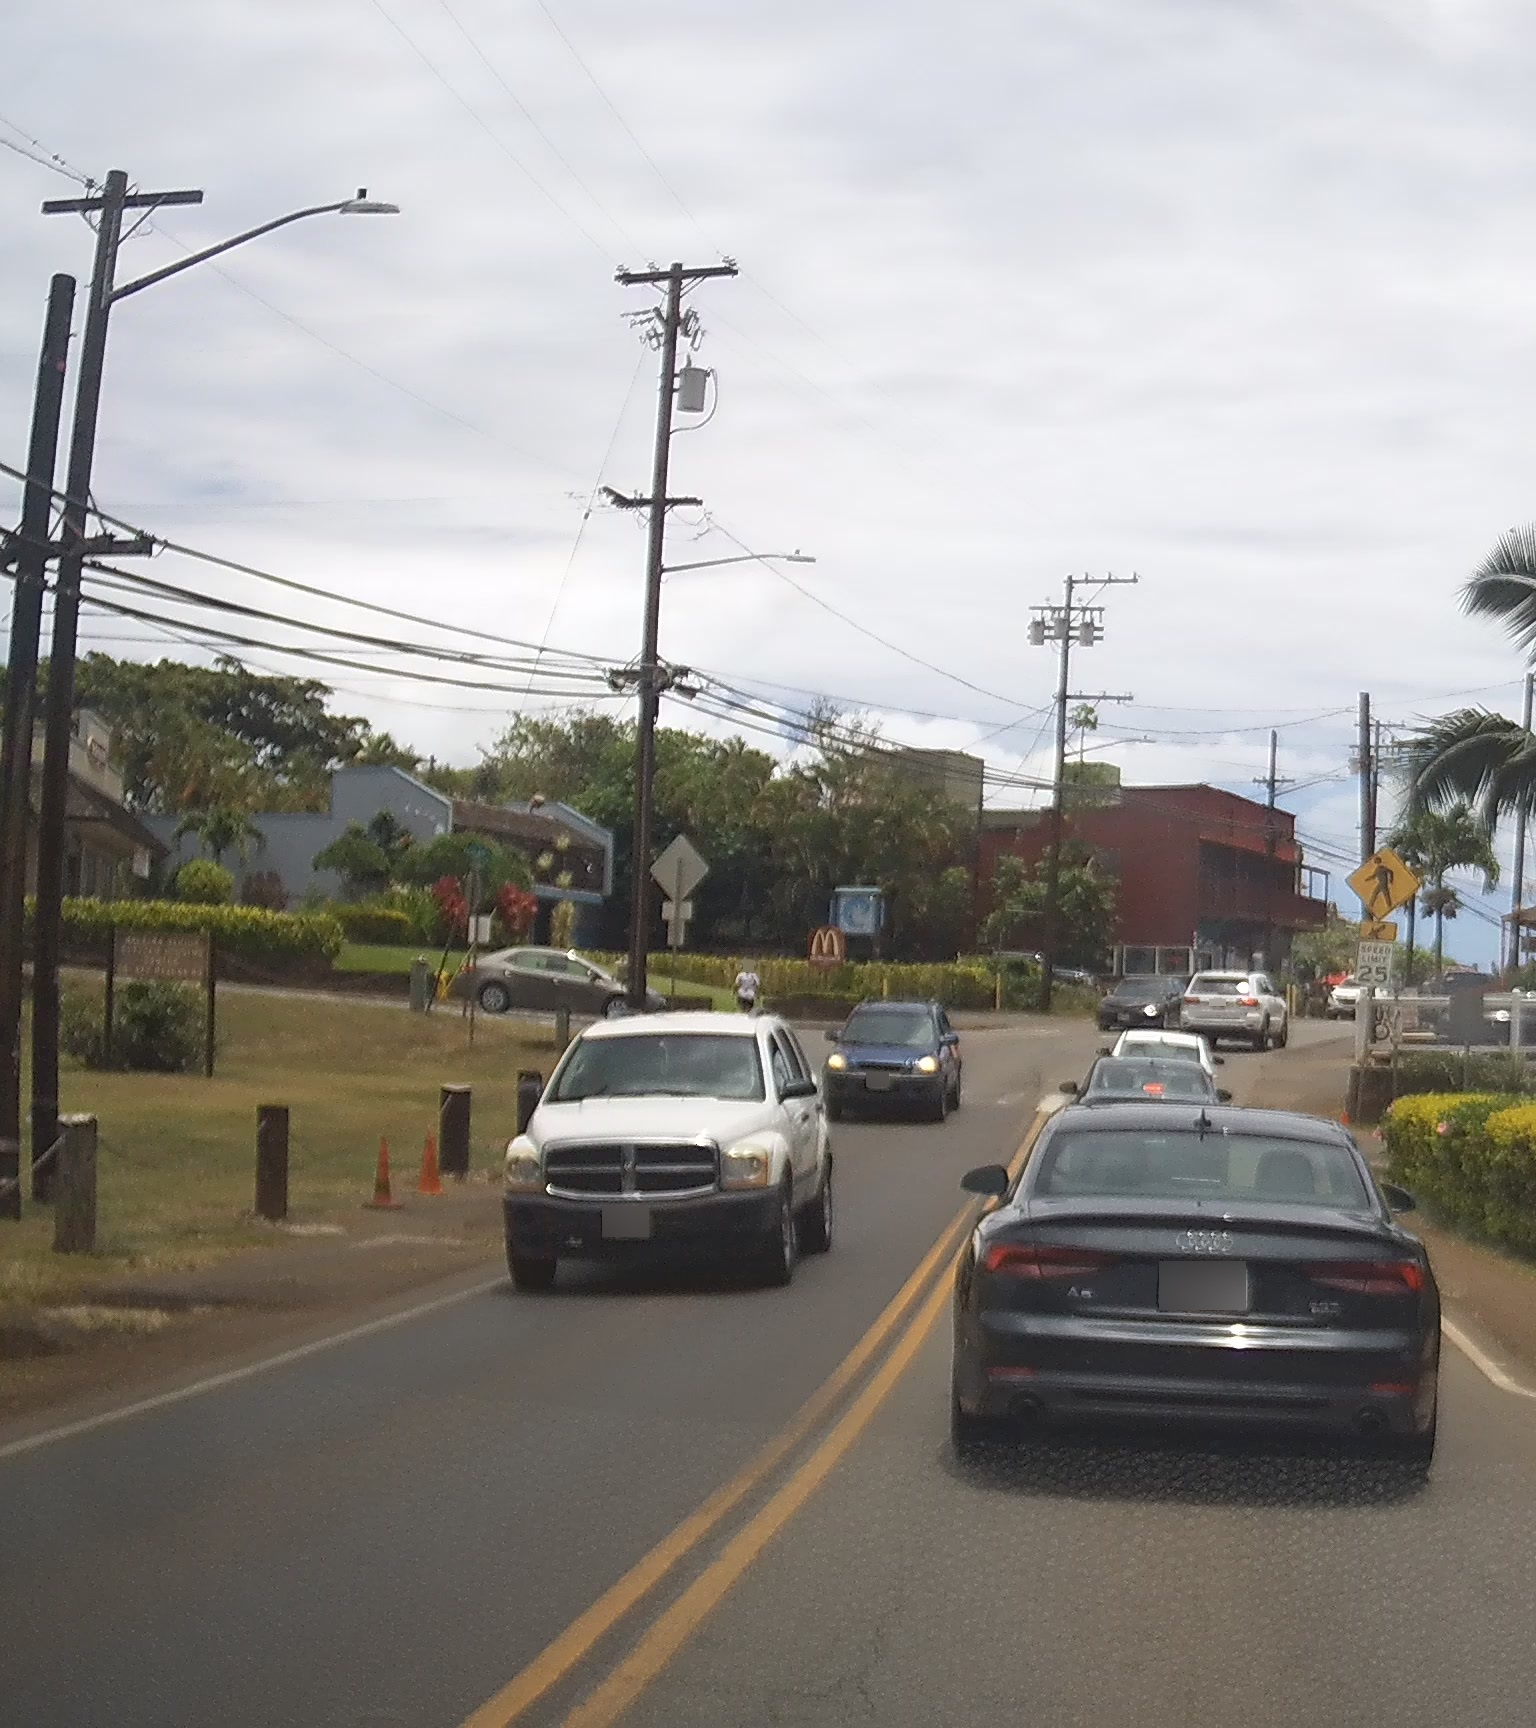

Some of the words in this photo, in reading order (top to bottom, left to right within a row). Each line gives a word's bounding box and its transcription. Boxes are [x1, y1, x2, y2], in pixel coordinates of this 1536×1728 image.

[1360, 945, 1391, 955] SPEED
[1361, 953, 1386, 963] LIMIT
[1358, 965, 1388, 983] 25
